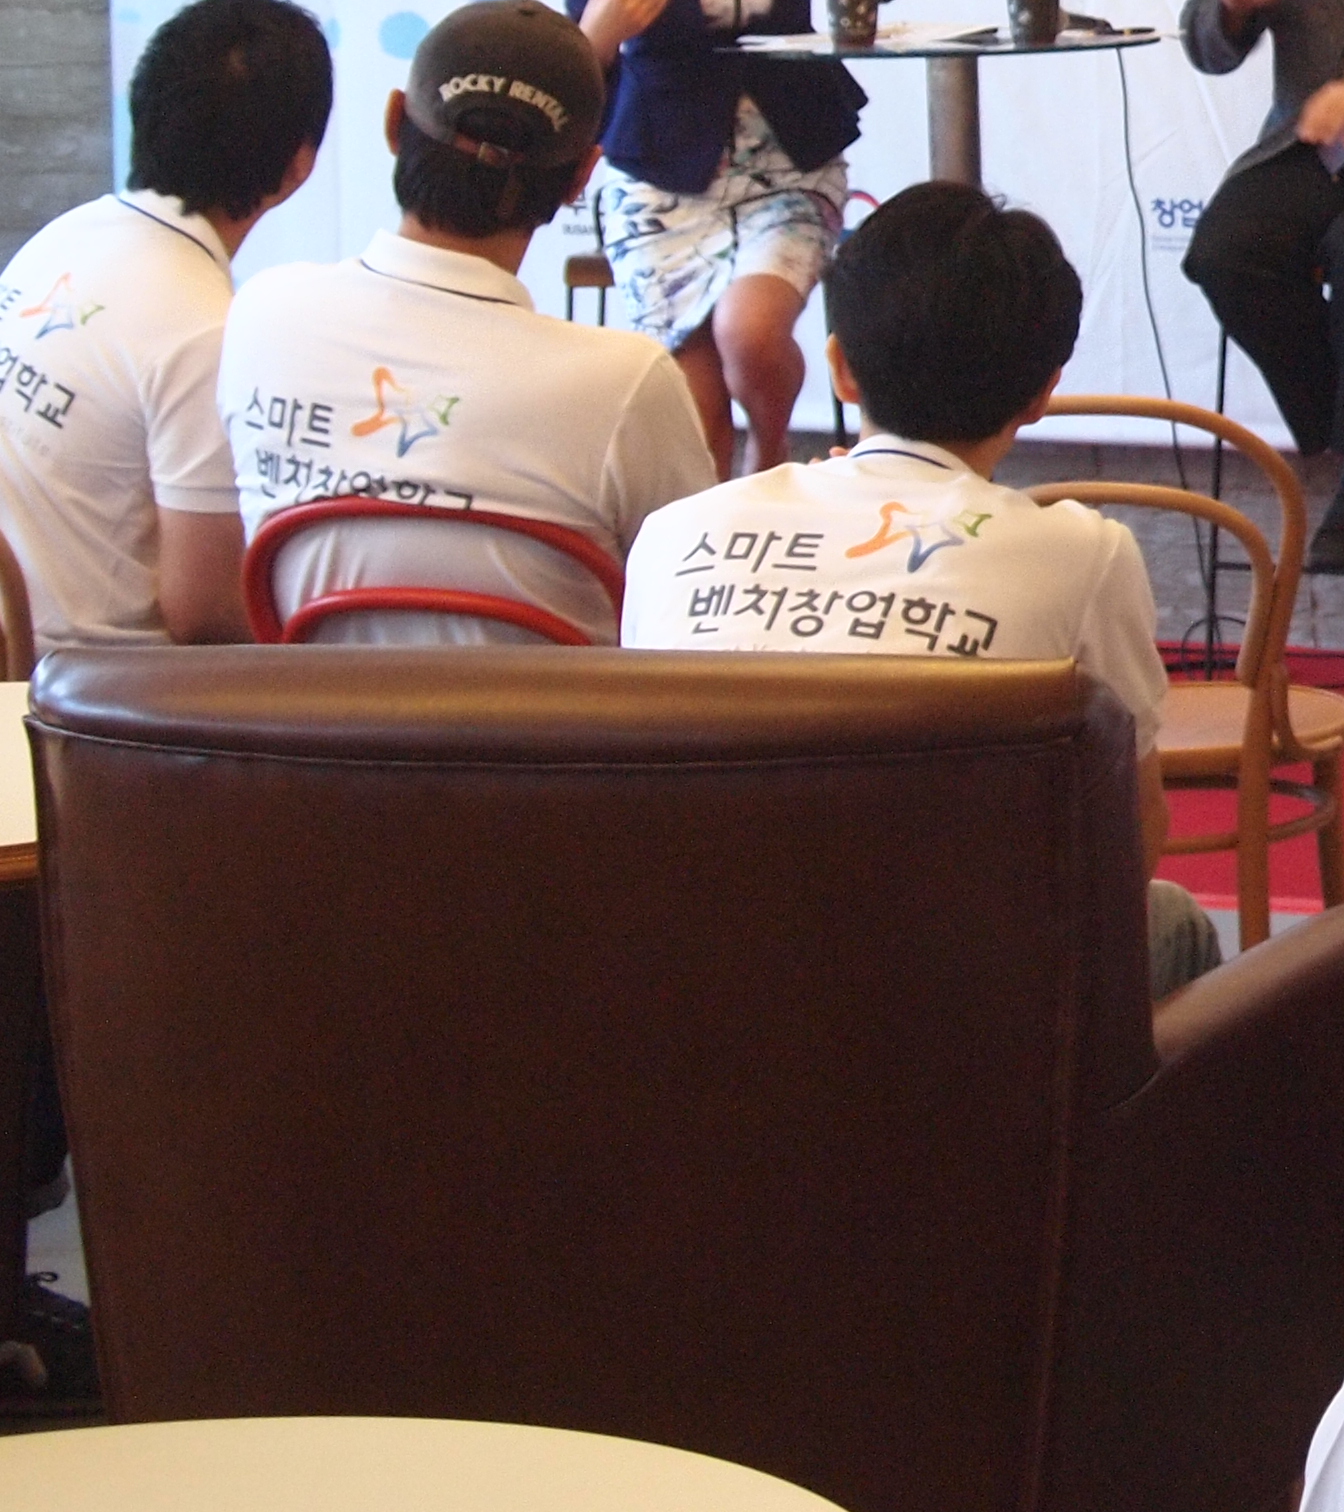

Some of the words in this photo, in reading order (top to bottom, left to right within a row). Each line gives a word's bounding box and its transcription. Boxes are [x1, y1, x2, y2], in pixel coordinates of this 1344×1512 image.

[438, 73, 506, 102] ROCKY
[508, 79, 569, 132] RENTAL
[245, 386, 333, 447] 스마트
[675, 531, 824, 576] 스마트
[687, 584, 998, 656] 벤처창업학교
